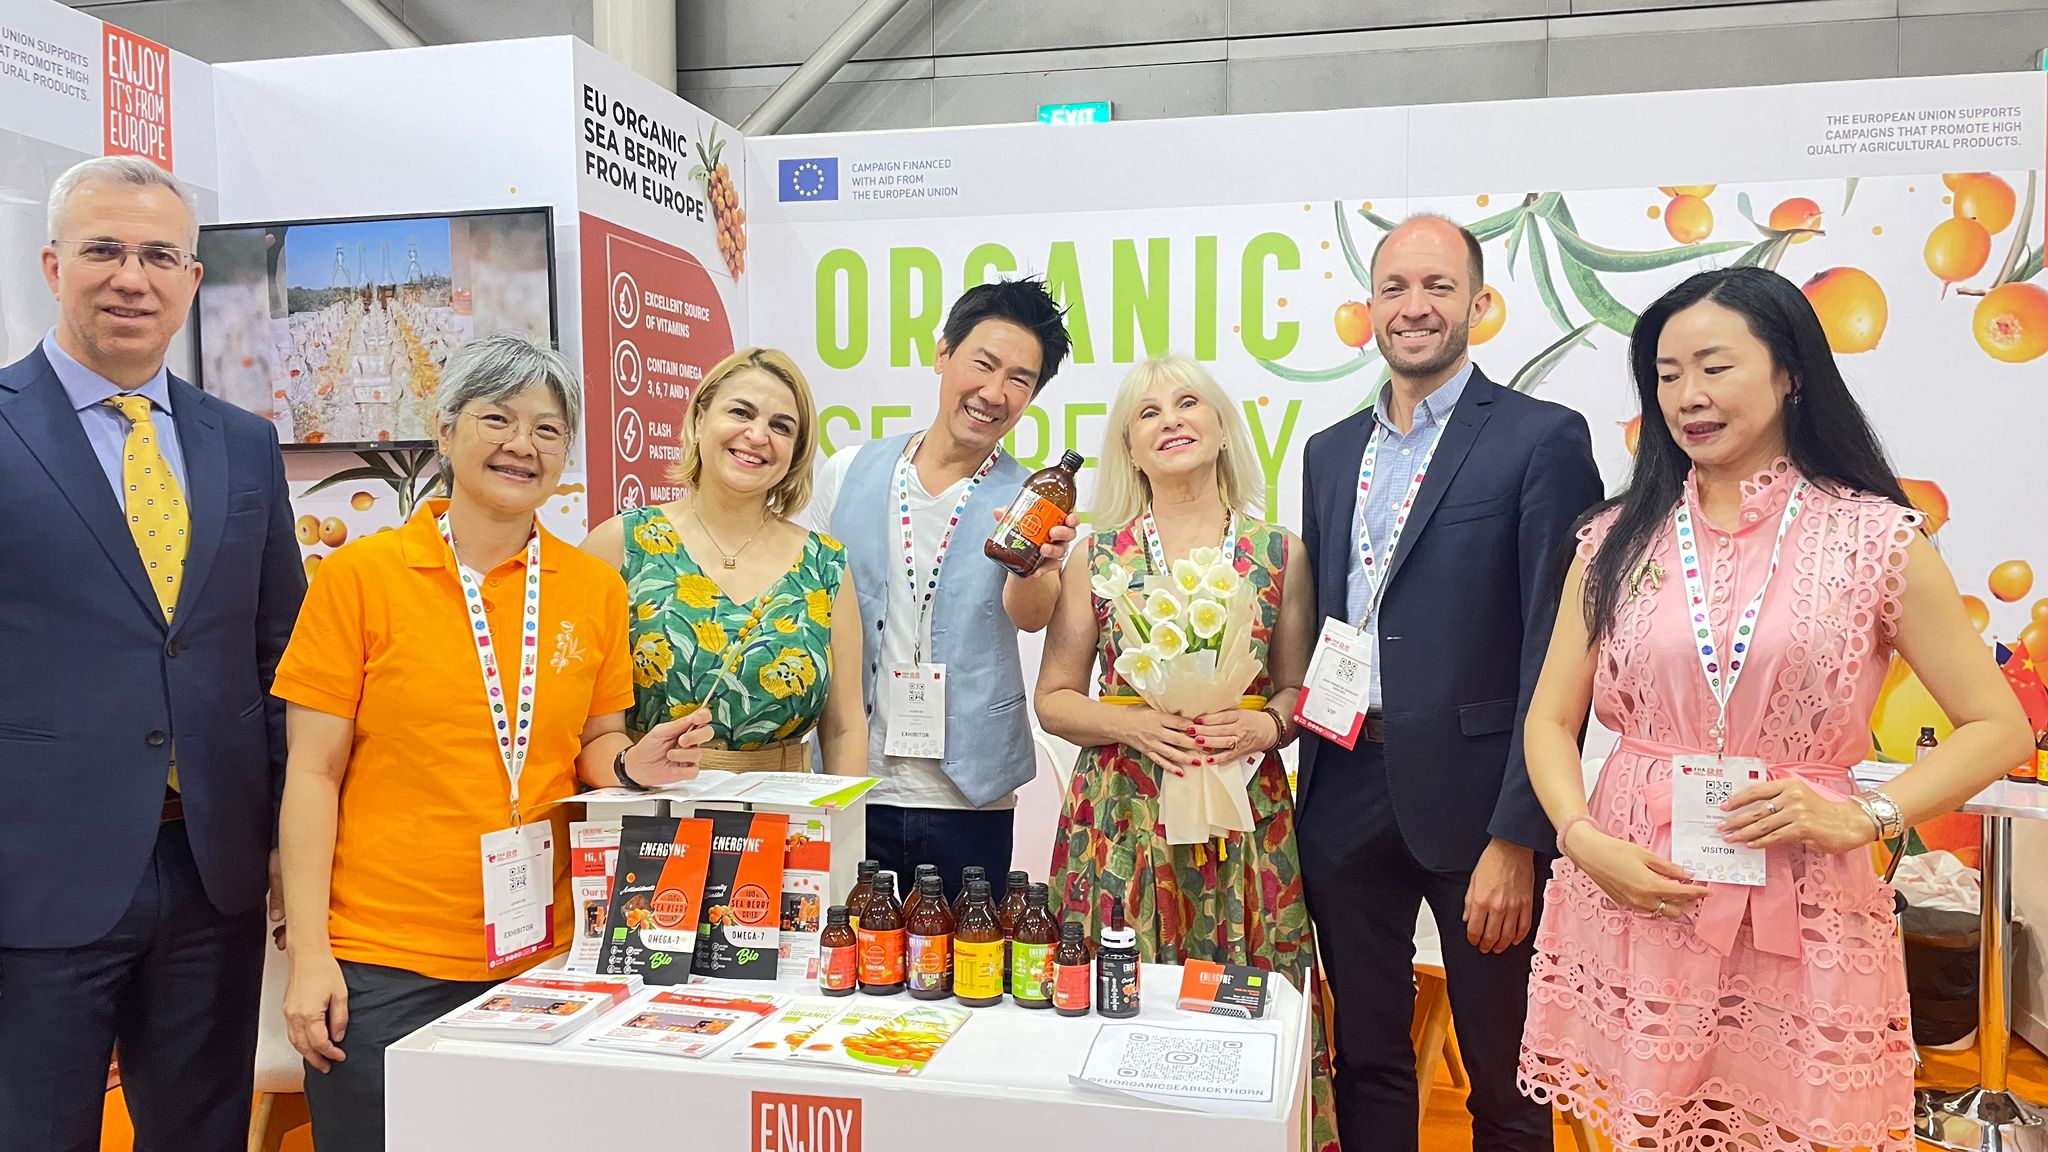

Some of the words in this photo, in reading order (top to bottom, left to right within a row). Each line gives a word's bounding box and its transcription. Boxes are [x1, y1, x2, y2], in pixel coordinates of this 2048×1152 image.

[2, 27, 35, 48] UNION
[37, 40, 89, 67] SUPPORTS
[13, 49, 63, 76] PROMOTE
[66, 67, 89, 85] HIGH
[108, 34, 165, 94] ENJOY
[33, 72, 90, 101] PRODUCTS.
[110, 79, 132, 114] IT'S
[136, 89, 165, 125] FROM
[583, 83, 607, 117] EU
[613, 101, 687, 158] ORGANIC
[1826, 115, 1849, 125] THE
[1852, 111, 1915, 124] EUROPEAN
[1918, 109, 1956, 121] UNION
[1958, 106, 2021, 119] SUPPORTS
[110, 109, 166, 161] EUROPE
[1825, 127, 1894, 140] CAMPAIGNS
[1897, 126, 1927, 137] THAT
[1930, 123, 1989, 135] PROMOTE
[1993, 121, 2022, 132] HIGH
[584, 117, 620, 156] SEA
[624, 136, 677, 181] BERRY
[1807, 143, 1857, 155] QUALITY
[1859, 140, 1950, 153] AGRICULTURAL
[1953, 136, 2021, 148] PRODUCTS.
[851, 161, 901, 173] CAMPAIGN
[903, 159, 951, 170] FINANCED
[586, 150, 637, 195] FROM
[642, 175, 704, 223] EUROPE
[851, 176, 877, 187] WITH
[878, 175, 895, 185] AID
[897, 174, 924, 185] FROM
[852, 190, 871, 200] THE
[873, 188, 925, 200] EUROPEAN
[927, 186, 958, 197] UNION
[644, 290, 684, 315] EXCELLENT
[684, 302, 710, 322] SOURCE
[816, 232, 1301, 369] ORANIC
[645, 315, 656, 330] OF
[656, 316, 690, 338] VITAMINS
[646, 357, 678, 377] CONTAIN
[679, 362, 703, 380] OMEGA
[647, 380, 655, 397] 3,
[655, 381, 663, 399] 6,
[663, 383, 669, 396] 7
[669, 383, 684, 399] AND
[684, 386, 690, 400] 9
[648, 421, 672, 438] FLASH
[649, 444, 683, 461] PASTEURI
[650, 486, 671, 501] MADE
[639, 842, 687, 857] ENERGYNE
[712, 836, 760, 853] ENERGYNE
[1701, 846, 1735, 855] VISITOR
[582, 888, 600, 897] Our
[731, 899, 744, 908] SEA
[746, 900, 770, 909] BERRY
[504, 923, 534, 938] EXHIBITOR
[647, 934, 680, 945] OMEGA-7
[731, 930, 765, 941] OMEGA-7
[649, 951, 673, 969] Bio
[735, 948, 760, 965] Bio
[785, 1011, 831, 1019] ORGANIC
[760, 1102, 853, 1152] ENJOY
